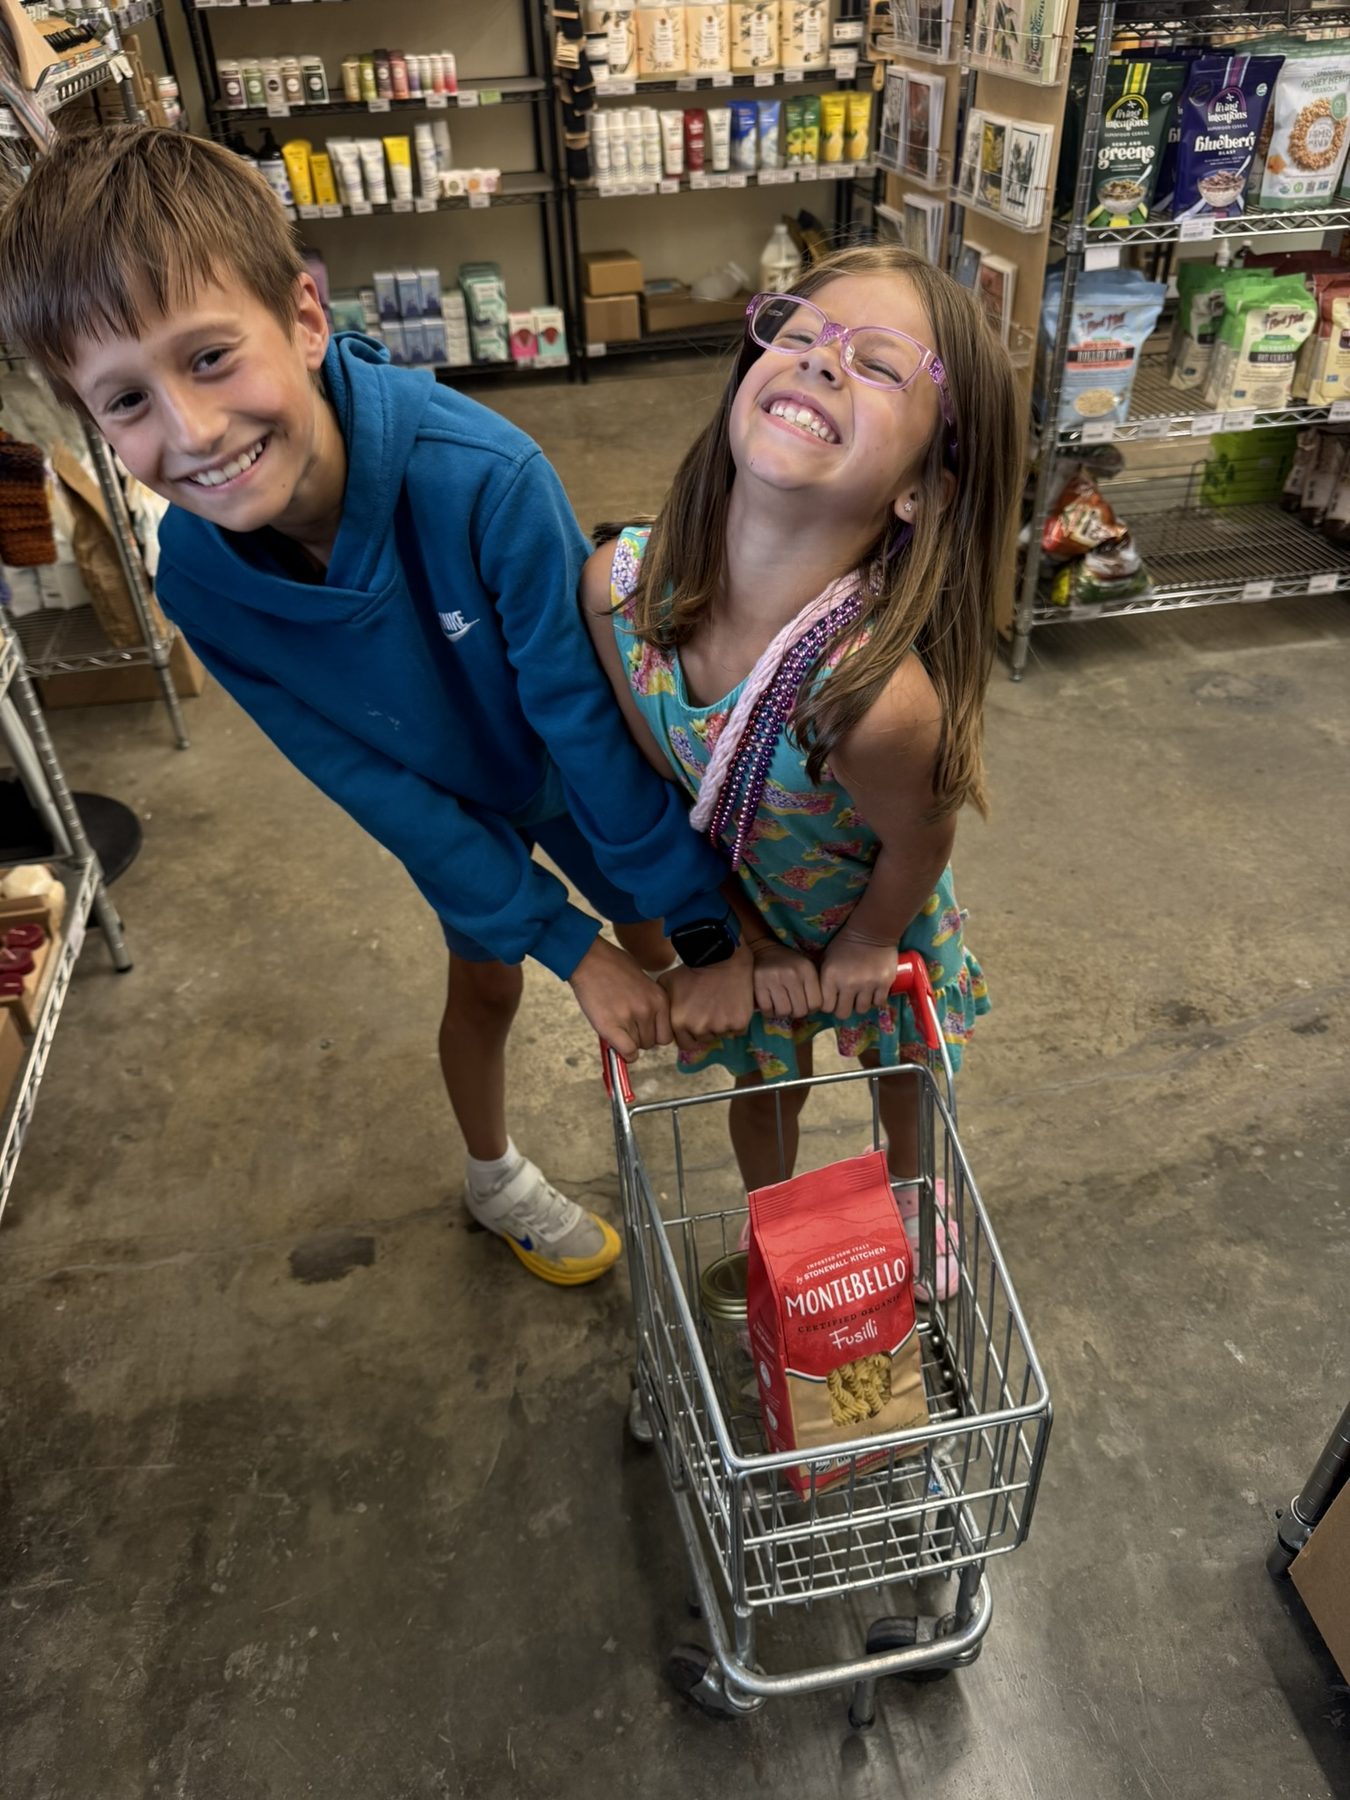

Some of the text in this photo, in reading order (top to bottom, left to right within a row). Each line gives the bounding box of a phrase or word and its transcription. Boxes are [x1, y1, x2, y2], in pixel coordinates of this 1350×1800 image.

[1194, 131, 1256, 152] blueberry
[1097, 145, 1155, 170] greens
[796, 1246, 887, 1285] by STONEWALL KITCHEN
[806, 1243, 870, 1270] IMPORTED FROM ITALY
[785, 1258, 906, 1318] MONTEBELLO
[798, 1314, 858, 1333] CERTIFIED
[828, 1318, 878, 1350] Fusilli
